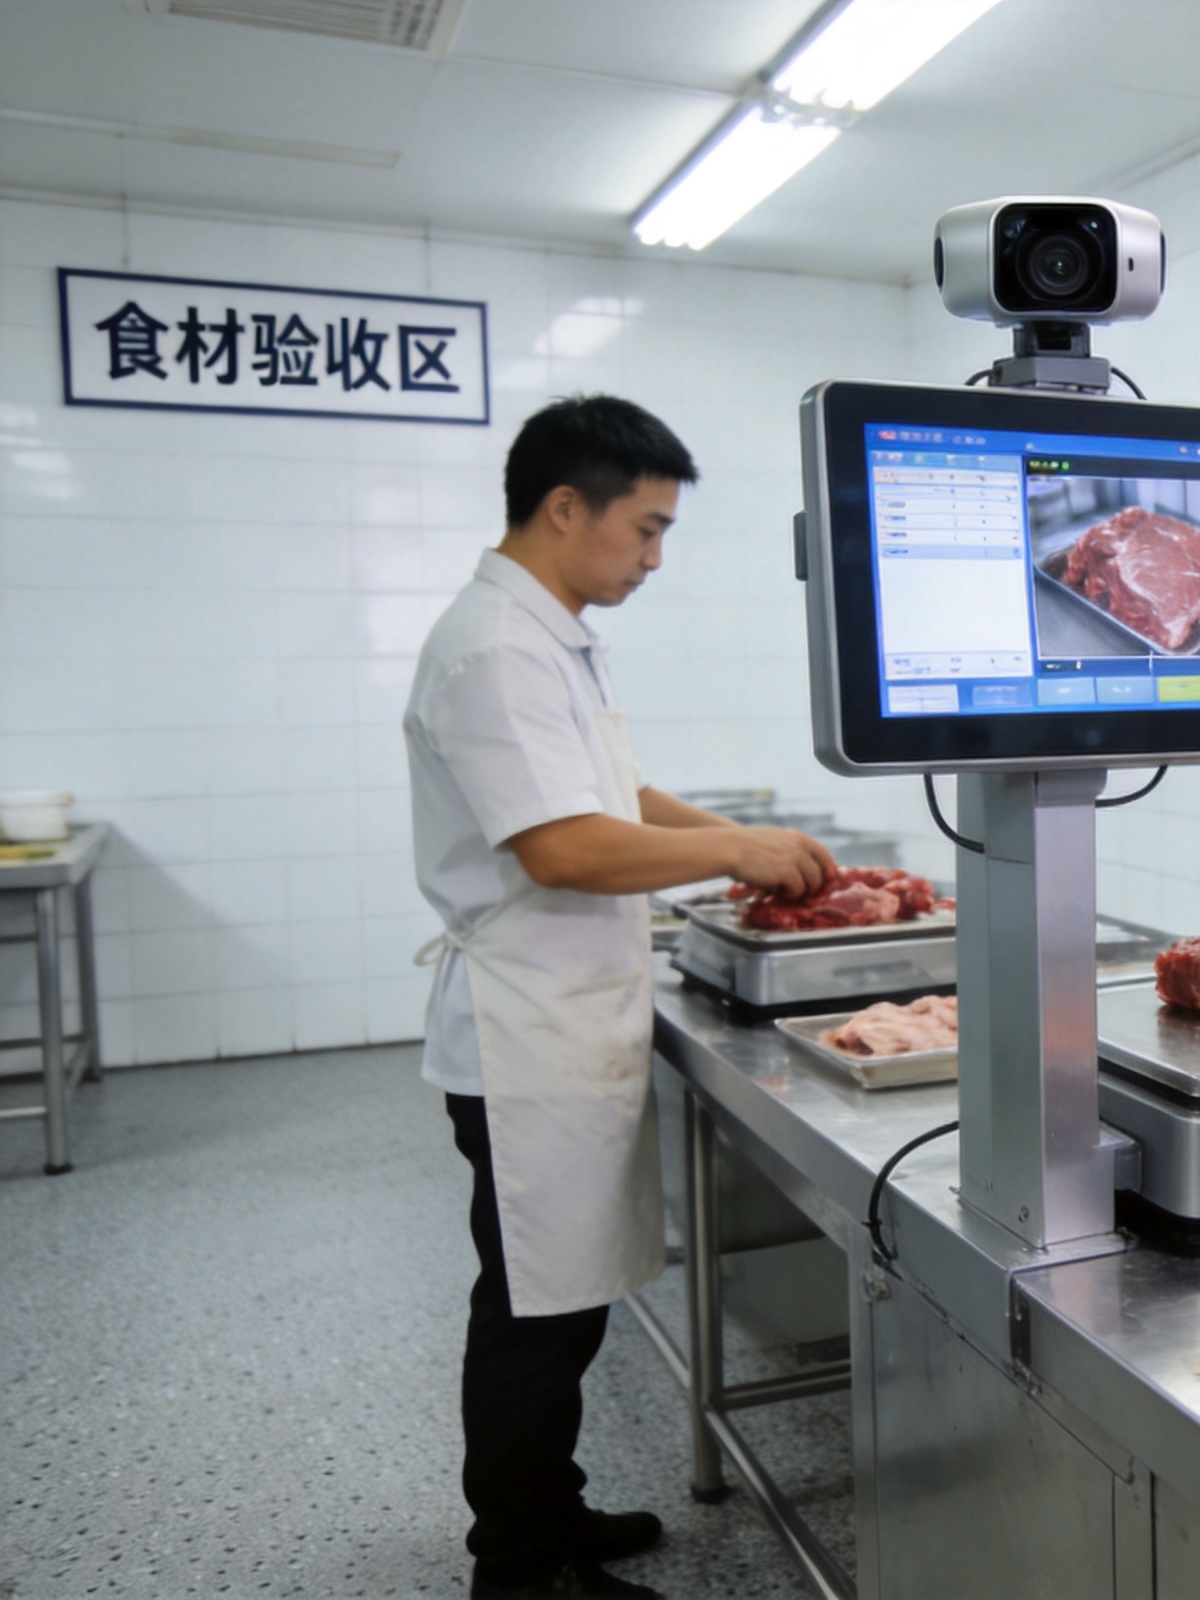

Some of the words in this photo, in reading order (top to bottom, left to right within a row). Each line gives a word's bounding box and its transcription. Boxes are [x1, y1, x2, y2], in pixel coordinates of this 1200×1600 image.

[95, 301, 460, 393] 食材验收区
